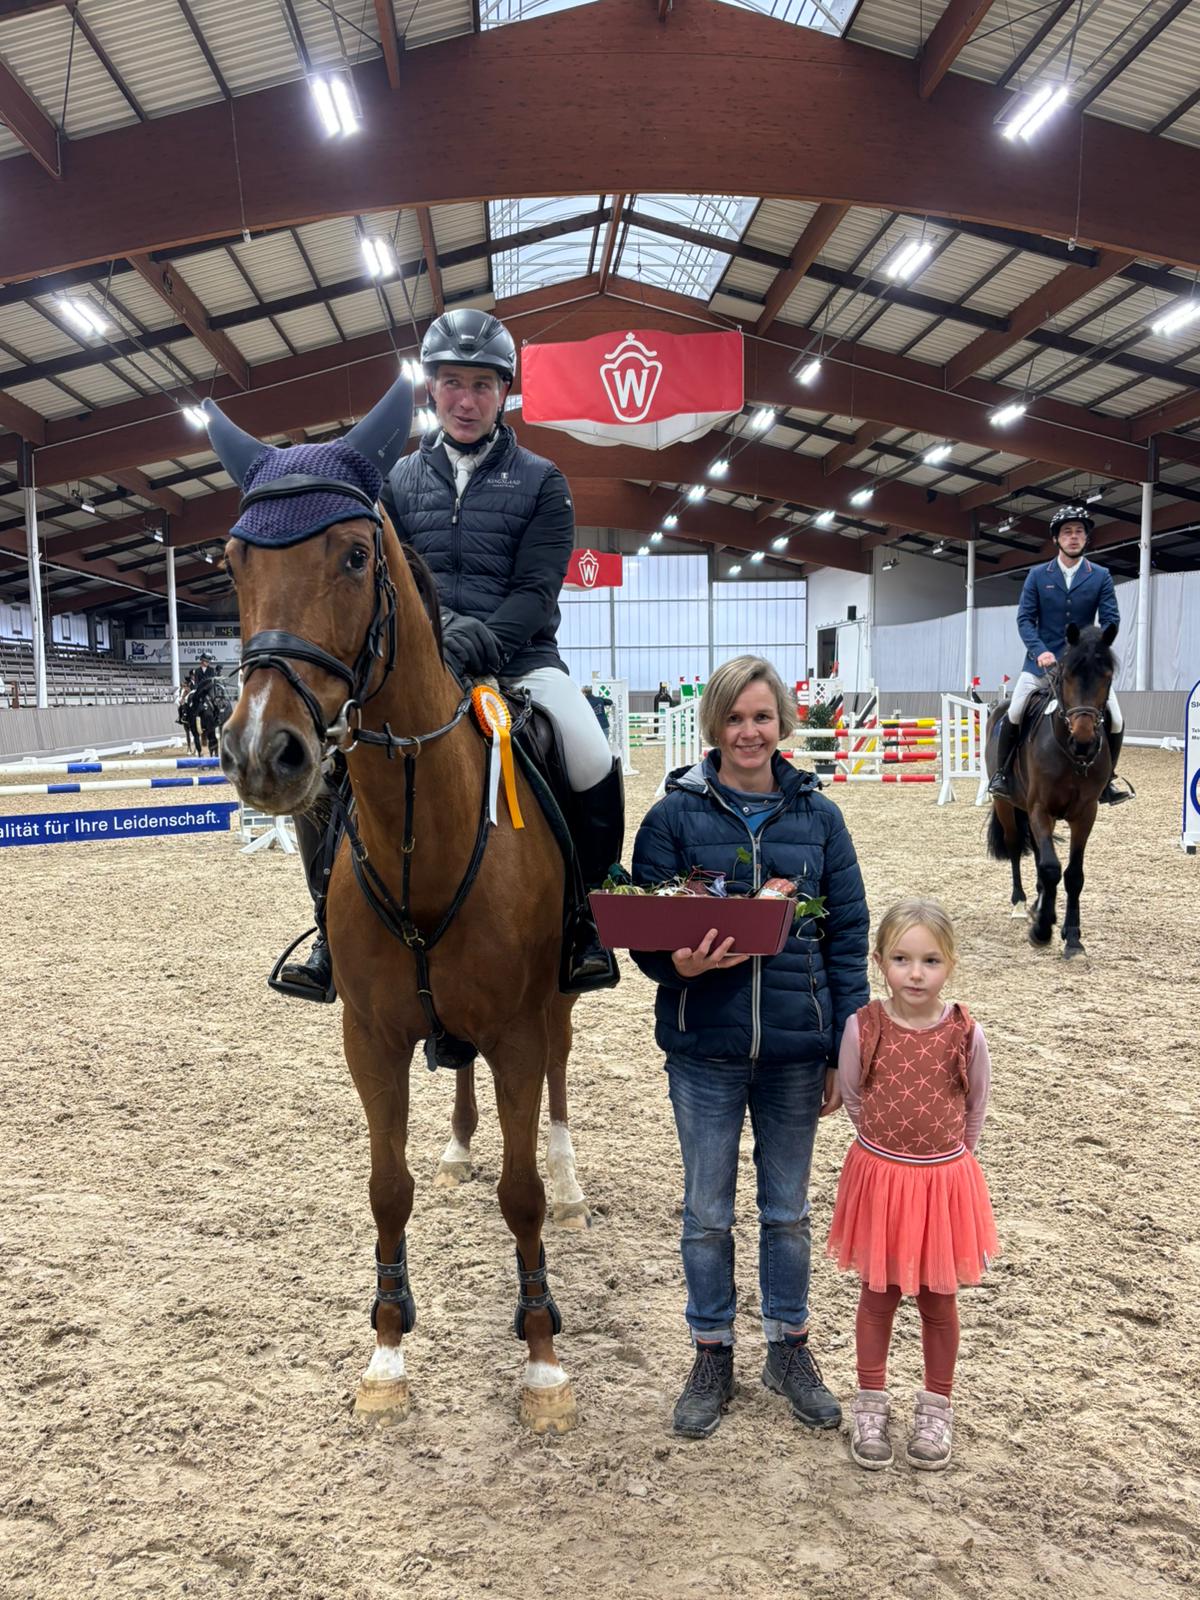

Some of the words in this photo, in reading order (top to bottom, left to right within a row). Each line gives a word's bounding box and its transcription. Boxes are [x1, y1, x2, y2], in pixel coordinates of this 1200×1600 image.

[612, 368, 649, 409] W
[584, 564, 595, 580] W
[44, 820, 70, 835] für
[75, 818, 108, 833] Ihre
[113, 810, 221, 830] Leidenschaft.
